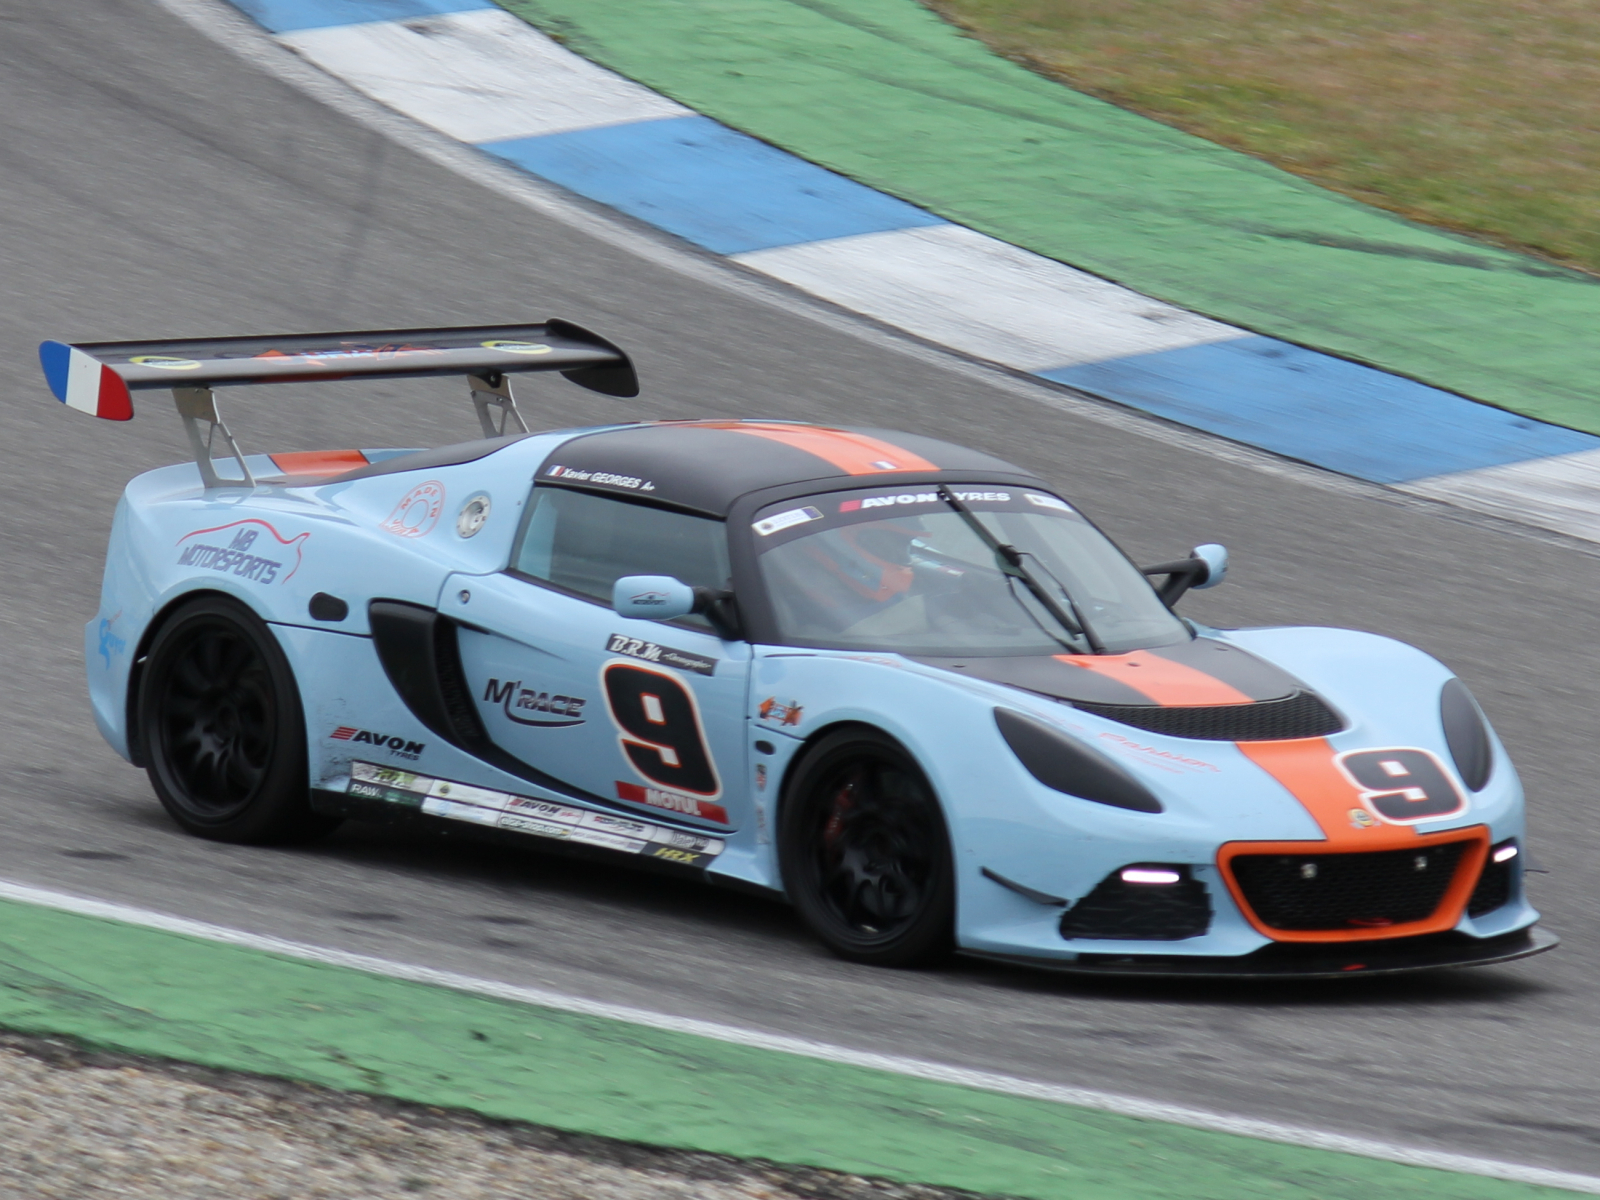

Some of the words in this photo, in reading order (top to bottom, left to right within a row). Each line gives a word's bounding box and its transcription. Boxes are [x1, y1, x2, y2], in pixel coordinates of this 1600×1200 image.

[561, 468, 592, 481] Xavier
[590, 472, 642, 489] GEORGES
[400, 486, 438, 510] MADE
[429, 500, 440, 518] IN
[861, 492, 934, 509] AVON
[228, 528, 259, 552] MB
[176, 544, 282, 585] MOTORSPORTS
[483, 678, 587, 722] M'RACE
[352, 730, 425, 754] AVON
[602, 661, 721, 799] 9
[390, 750, 420, 761] TYRES
[1337, 748, 1466, 823] 9
[520, 801, 562, 814] AVON
[645, 788, 702, 816] MOTUL
[654, 847, 701, 863] HRX
